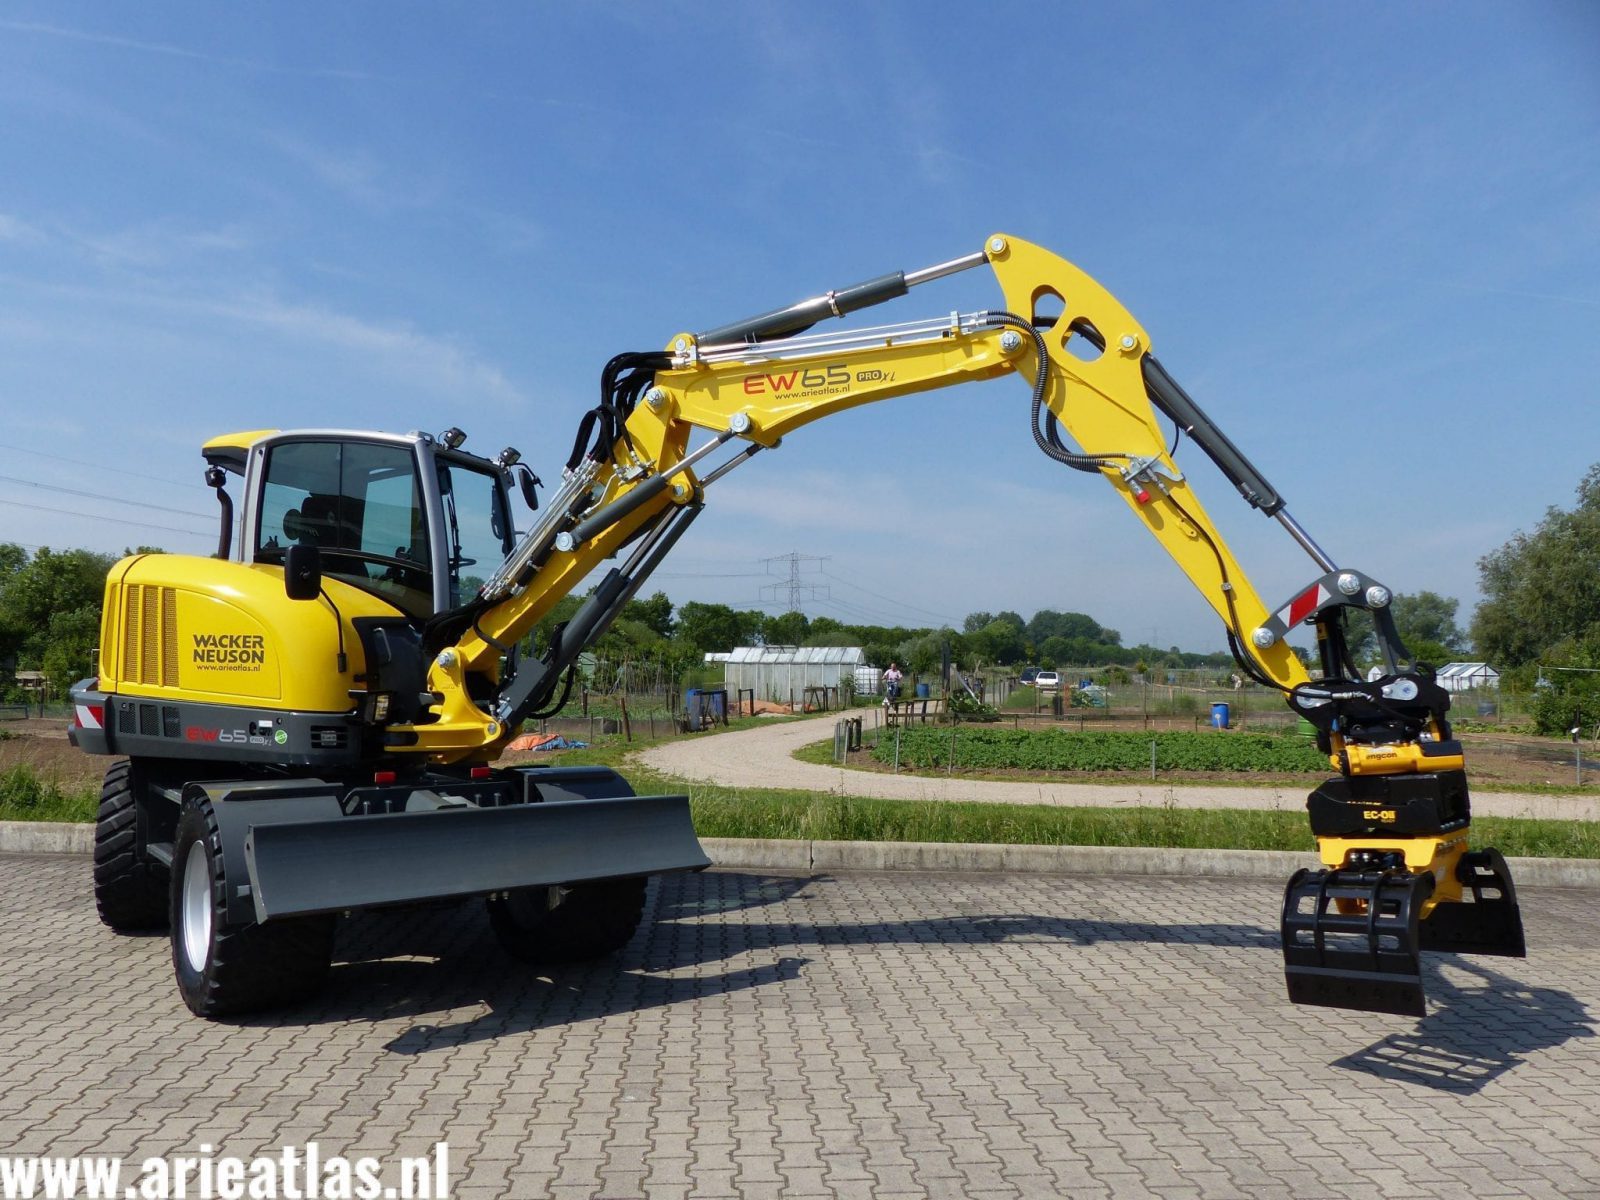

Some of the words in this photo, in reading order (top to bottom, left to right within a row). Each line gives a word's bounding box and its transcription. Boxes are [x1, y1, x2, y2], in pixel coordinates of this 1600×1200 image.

[743, 364, 851, 395] EW65
[857, 370, 882, 382] PRO
[774, 384, 850, 400] www.arieatlas.nl
[193, 634, 265, 649] WACKER
[193, 649, 265, 663] NEUSON
[196, 663, 261, 672] www.arieatlas.nl
[186, 727, 247, 743] EW65
[1366, 752, 1398, 760] engcon
